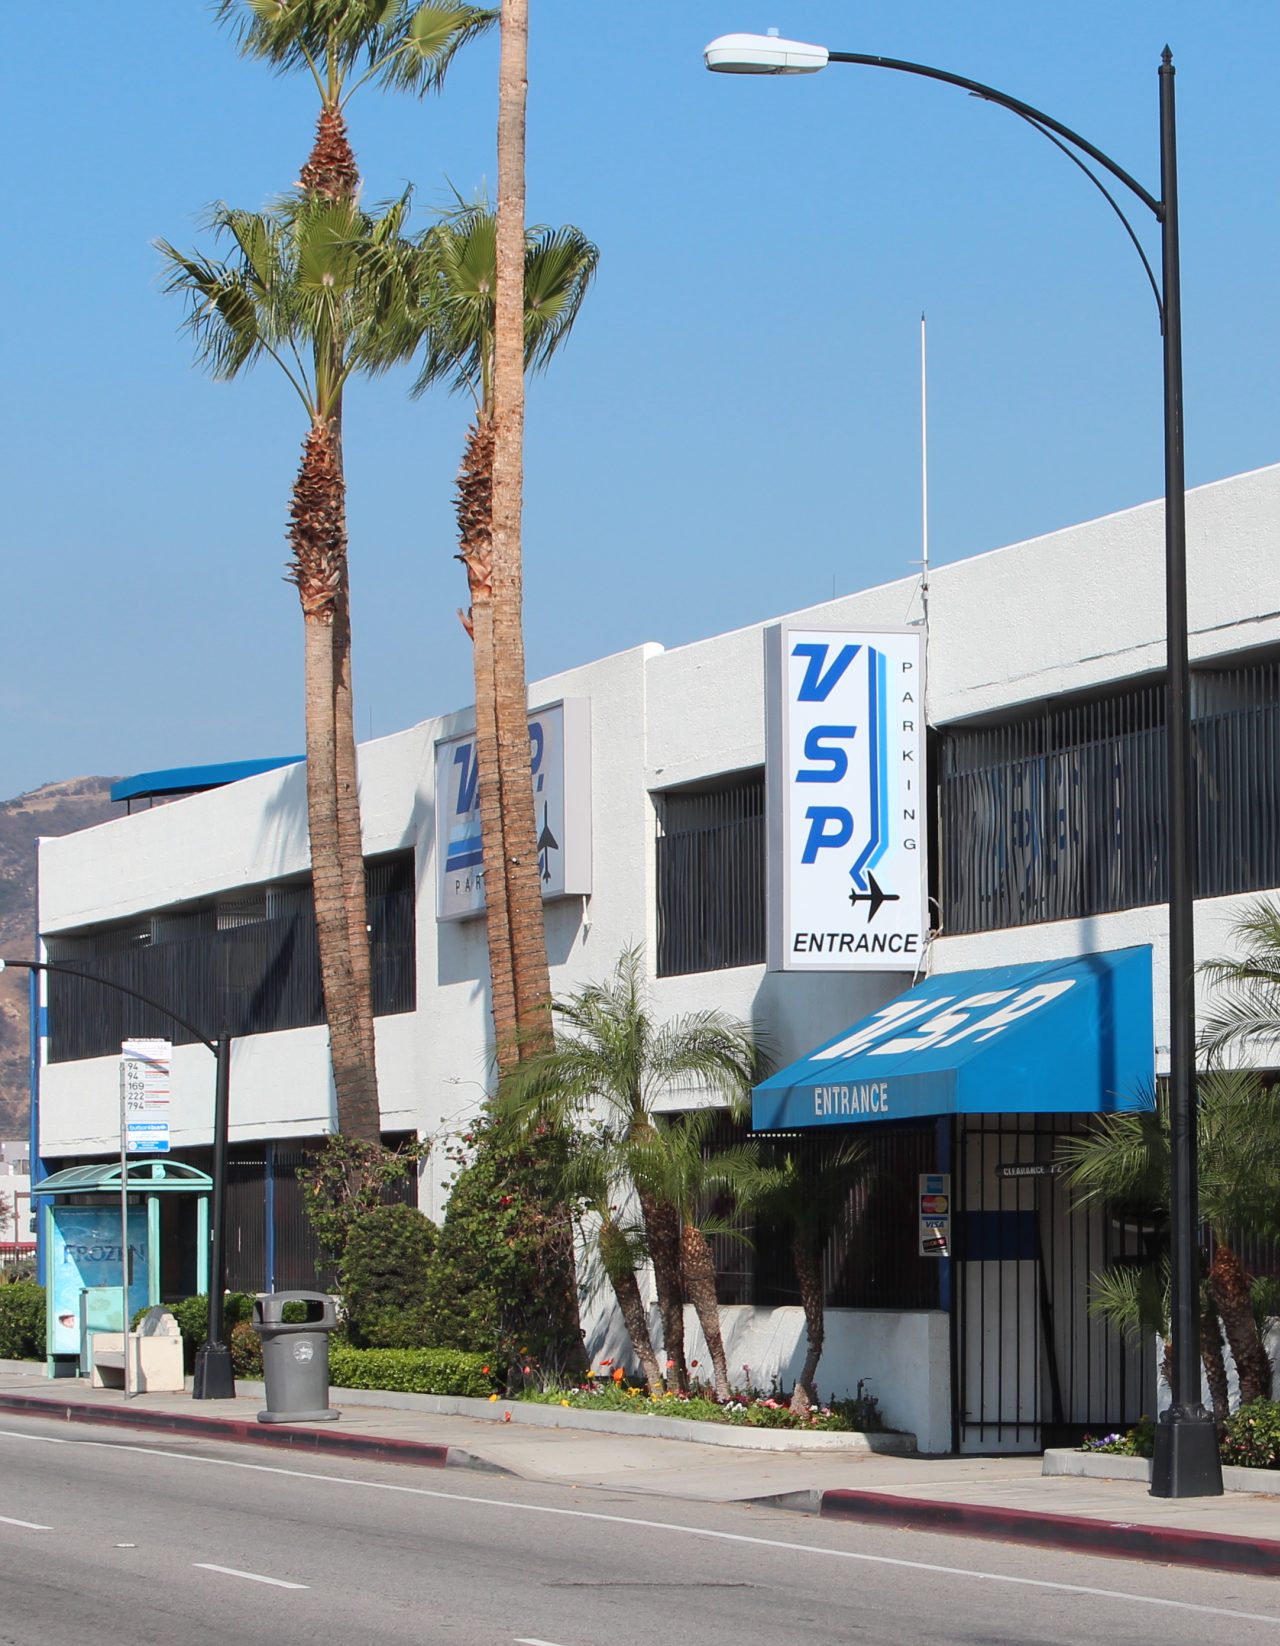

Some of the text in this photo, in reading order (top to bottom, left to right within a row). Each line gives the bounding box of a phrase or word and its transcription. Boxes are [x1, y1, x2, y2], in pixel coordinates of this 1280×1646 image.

[902, 661, 917, 851] PARKING
[792, 932, 918, 954] ENTRANCE
[127, 1062, 138, 1071] 94
[127, 1072, 138, 1080] 94
[128, 1082, 145, 1091] 169
[128, 1092, 145, 1101] 222
[814, 1082, 888, 1116] ENTRANCE
[127, 1101, 144, 1110] 794
[1003, 1166, 1046, 1176] CLEARANCE
[925, 1221, 945, 1229] VISA
